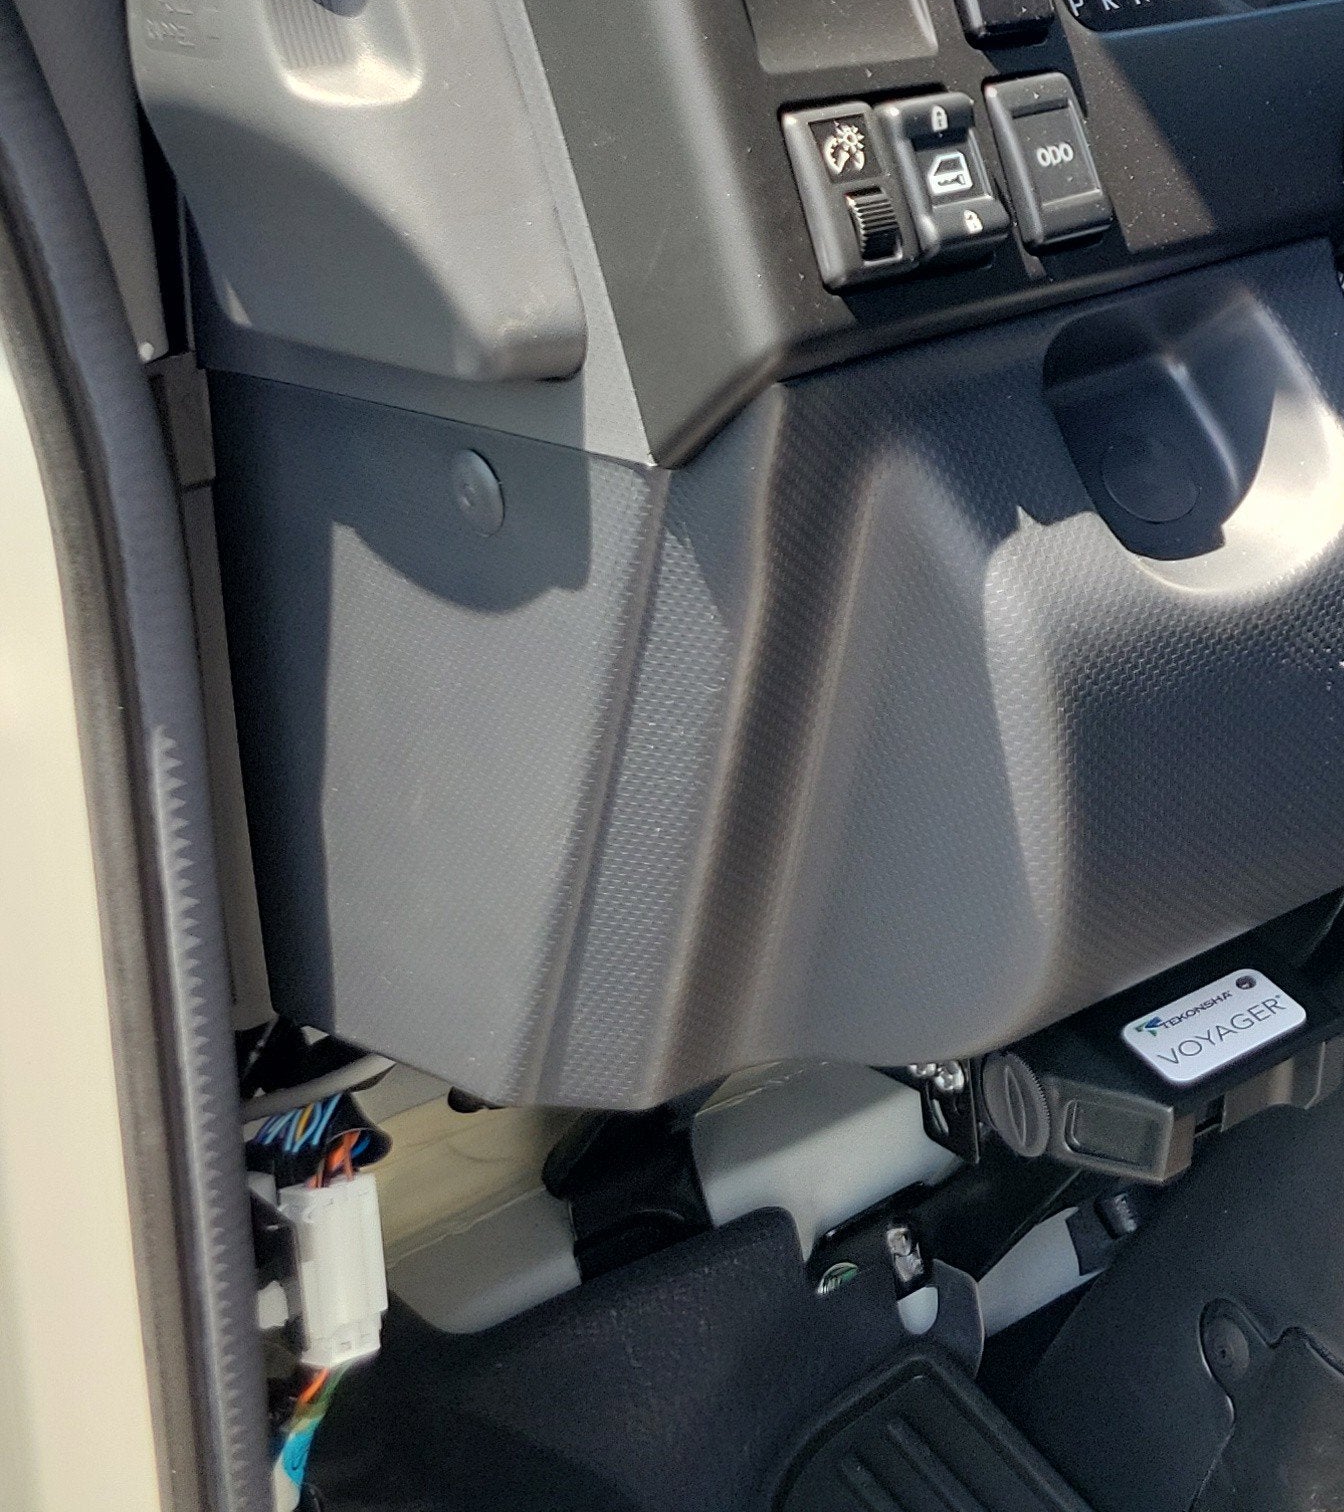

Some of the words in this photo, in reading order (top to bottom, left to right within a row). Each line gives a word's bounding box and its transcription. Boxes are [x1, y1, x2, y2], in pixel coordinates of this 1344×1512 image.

[1036, 142, 1074, 168] ODO
[1160, 990, 1232, 1028] TEKONSHA
[1158, 996, 1286, 1064] VOYAGER
